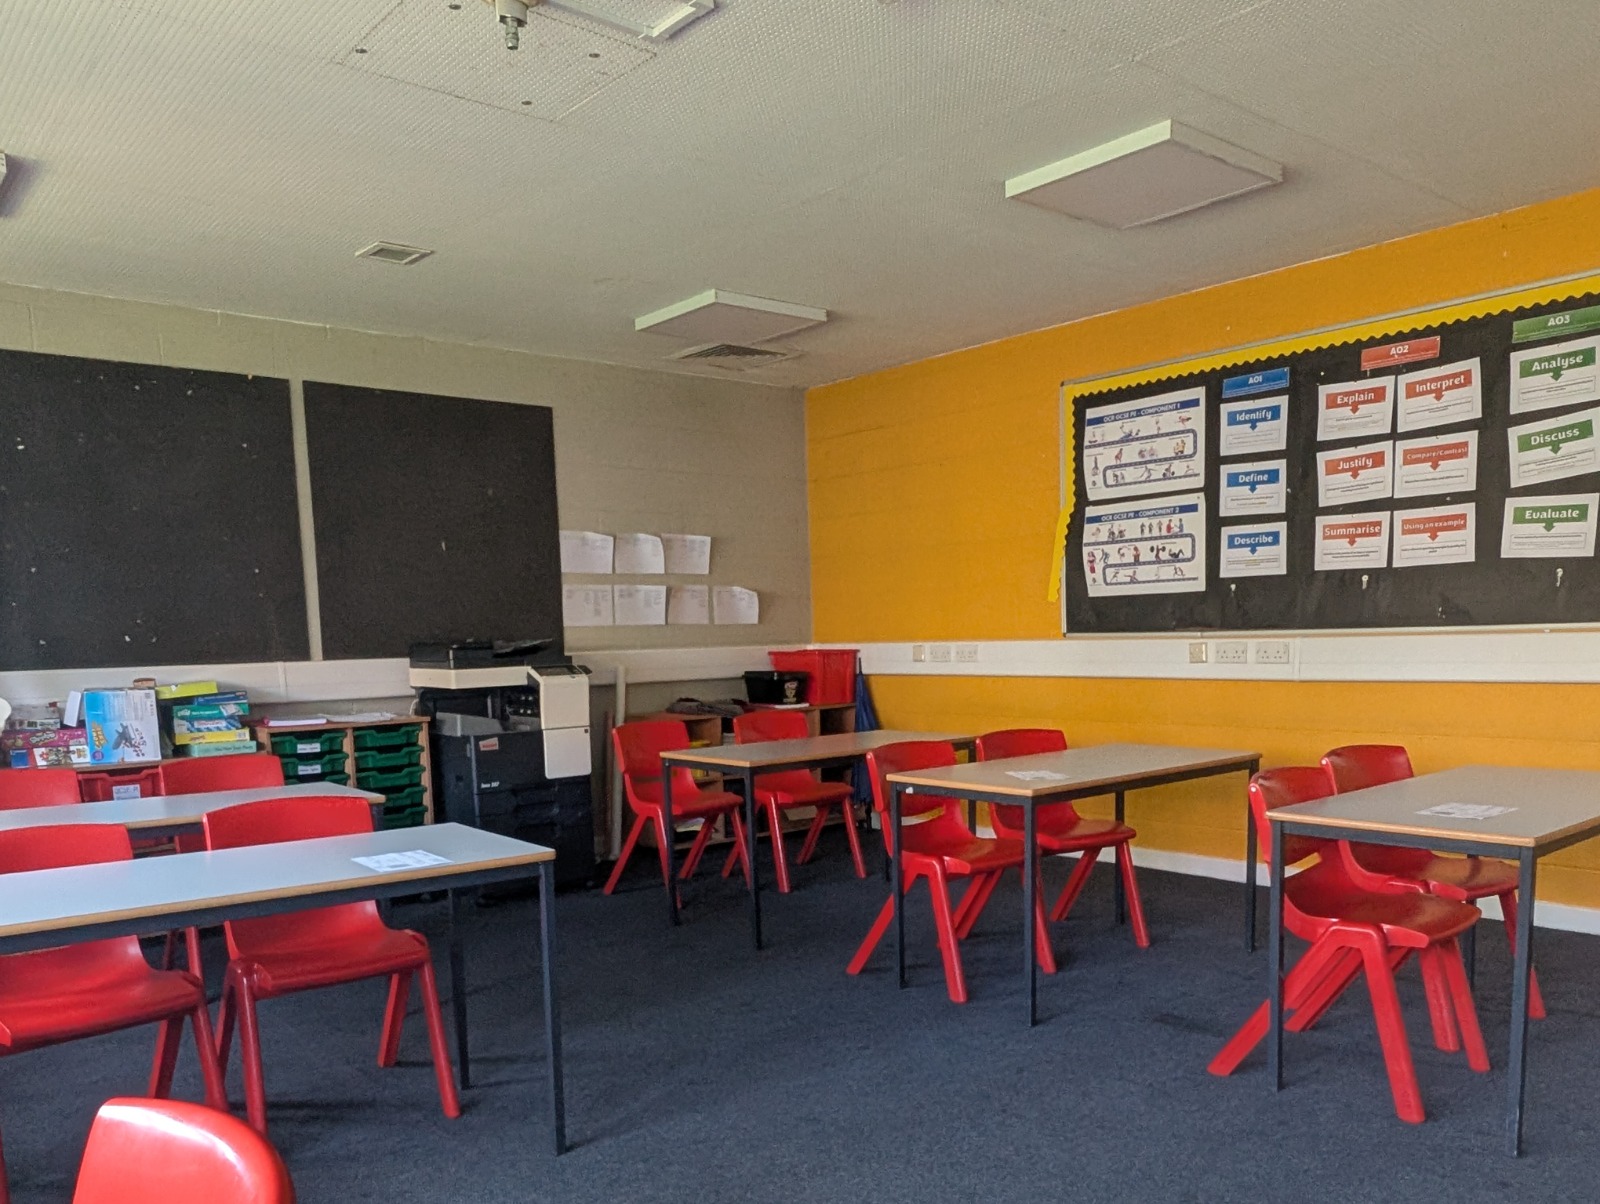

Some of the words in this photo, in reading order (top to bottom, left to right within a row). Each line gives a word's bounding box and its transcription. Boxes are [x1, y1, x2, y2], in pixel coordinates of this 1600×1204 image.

[1547, 314, 1570, 326] AO3
[1390, 345, 1409, 356] AO2
[1532, 355, 1583, 371] Analyse
[1416, 375, 1465, 393] Interpret
[1337, 391, 1375, 404] Explain
[1141, 403, 1176, 416] COMPONENT
[1236, 409, 1272, 421] Identify
[1530, 428, 1580, 445] Discuss
[1406, 446, 1468, 460] Compare/Contrast
[1337, 457, 1373, 470] Justify
[1238, 473, 1269, 483] Define
[1138, 507, 1174, 517] COMPONENT
[1525, 508, 1580, 519] Evaluate
[1434, 518, 1465, 528] example
[1324, 525, 1381, 536] Summarise
[1234, 534, 1273, 545] Describe
